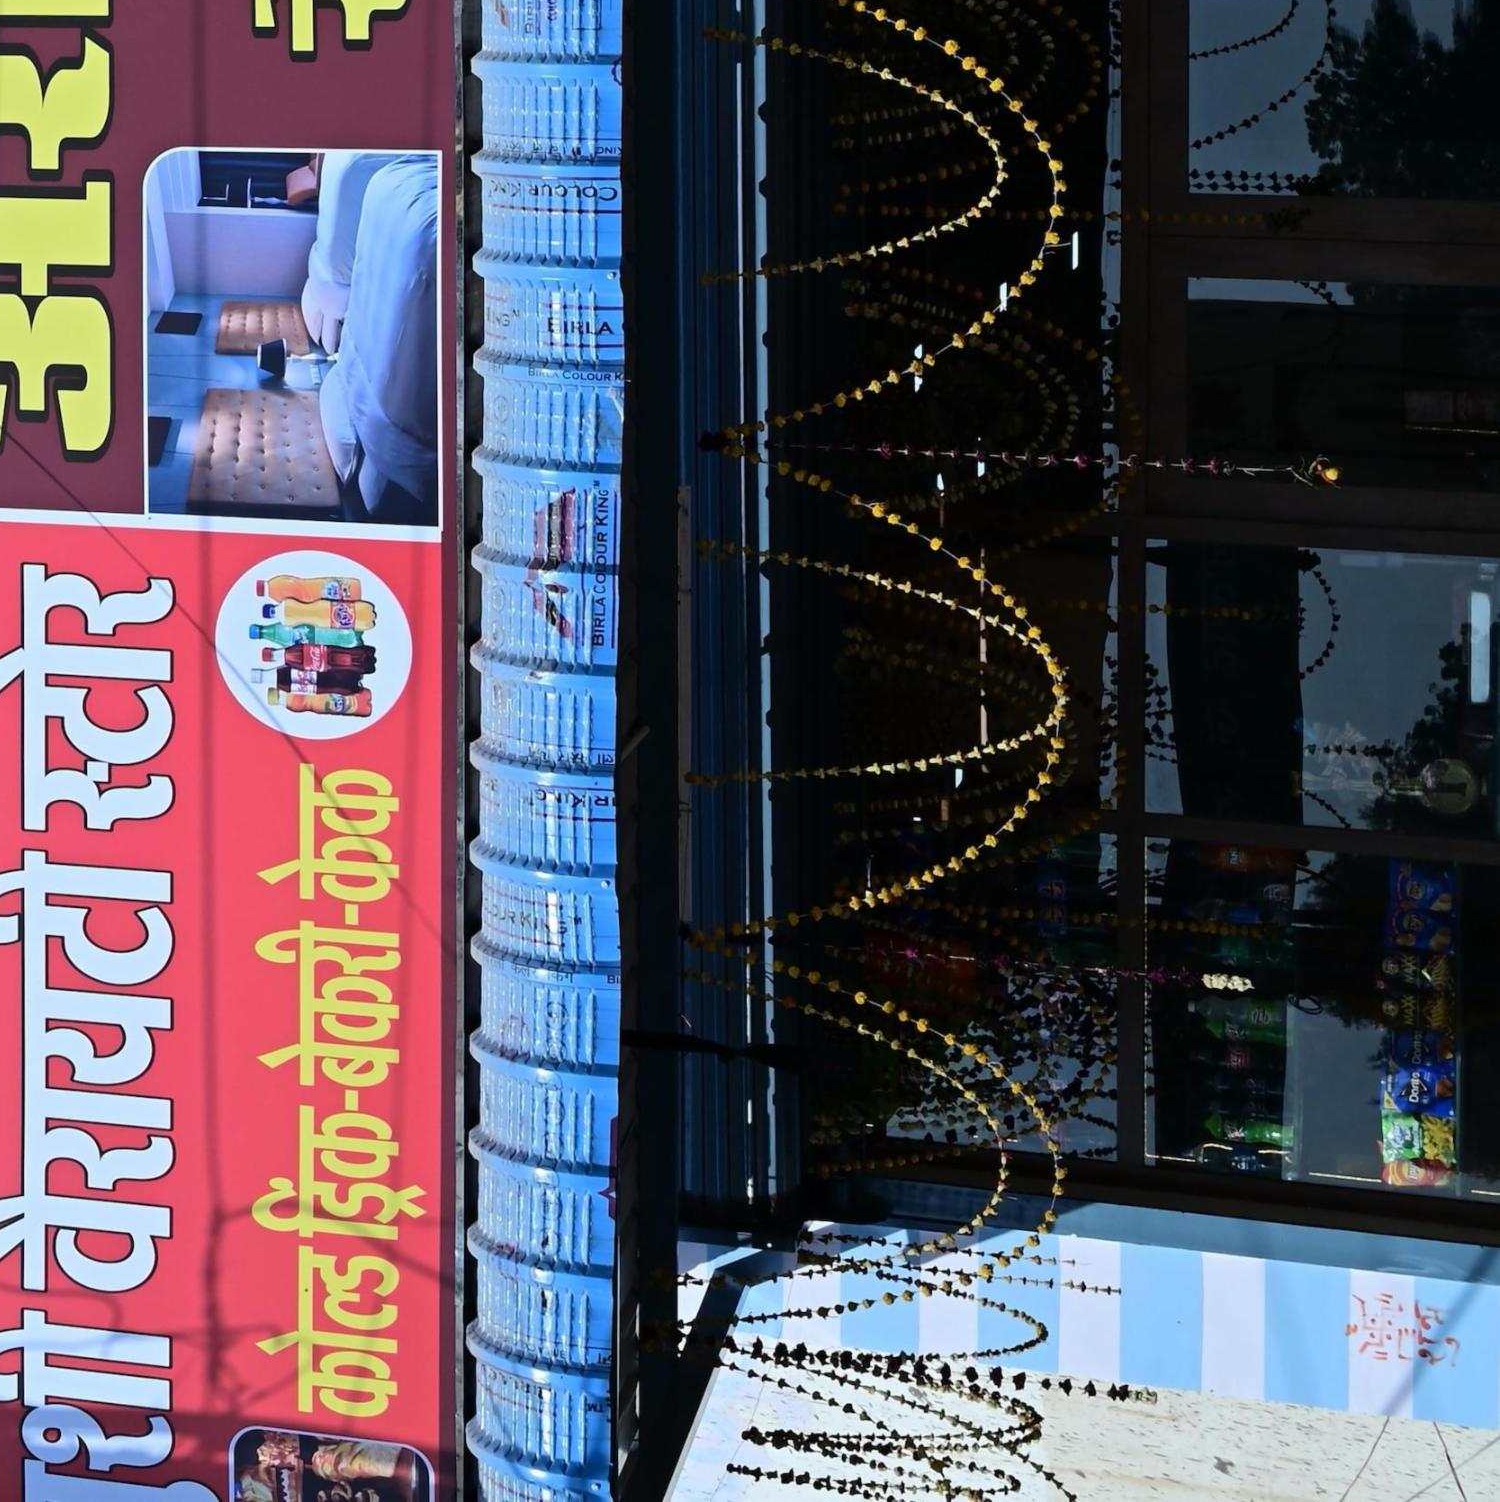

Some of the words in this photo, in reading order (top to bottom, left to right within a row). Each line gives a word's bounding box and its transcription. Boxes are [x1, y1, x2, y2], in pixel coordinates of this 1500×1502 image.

[595, 489, 610, 527] KING
[593, 532, 608, 595] COLOUR
[594, 597, 606, 647] BIRLA
[255, 1245, 400, 1419] कोल्ड
